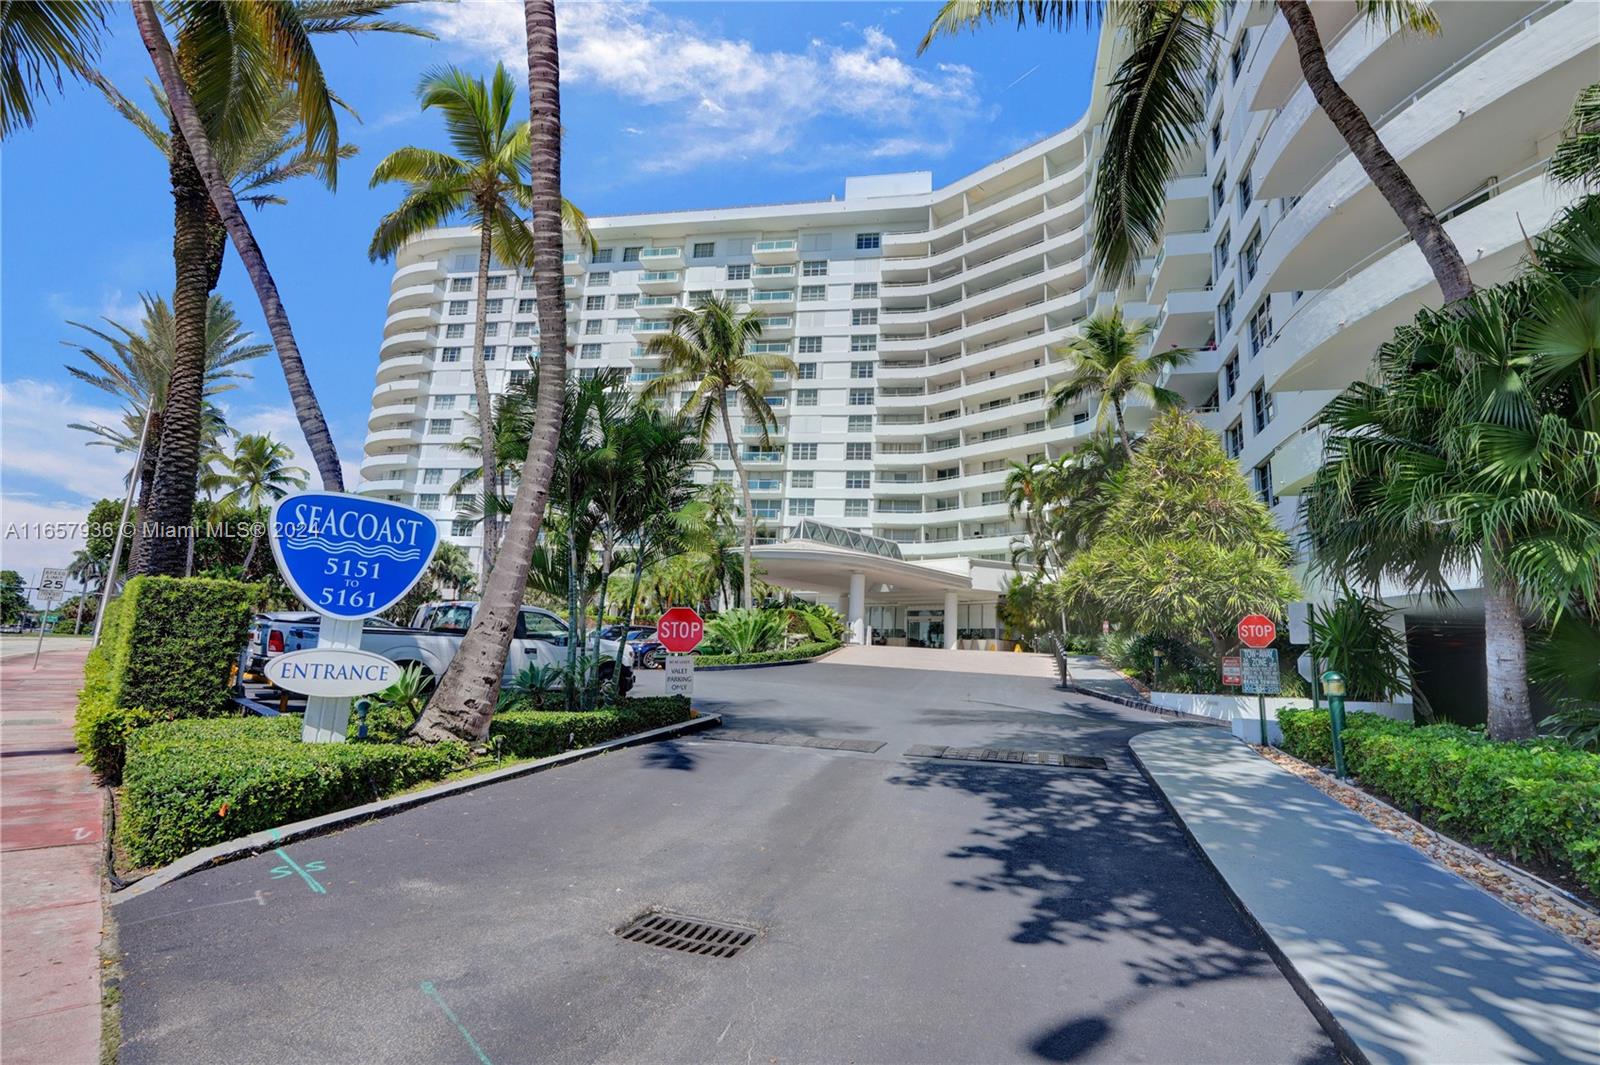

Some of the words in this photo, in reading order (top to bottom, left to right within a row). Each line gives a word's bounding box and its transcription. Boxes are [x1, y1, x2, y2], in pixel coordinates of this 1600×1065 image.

[295, 503, 423, 546] SEACOAST
[324, 557, 380, 580] 5151
[43, 579, 63, 589] 25
[344, 579, 359, 588] TO
[319, 587, 376, 608] 5161
[661, 621, 700, 639] STOP
[1241, 624, 1273, 637] STOP
[280, 662, 389, 681] ENTRANCE
